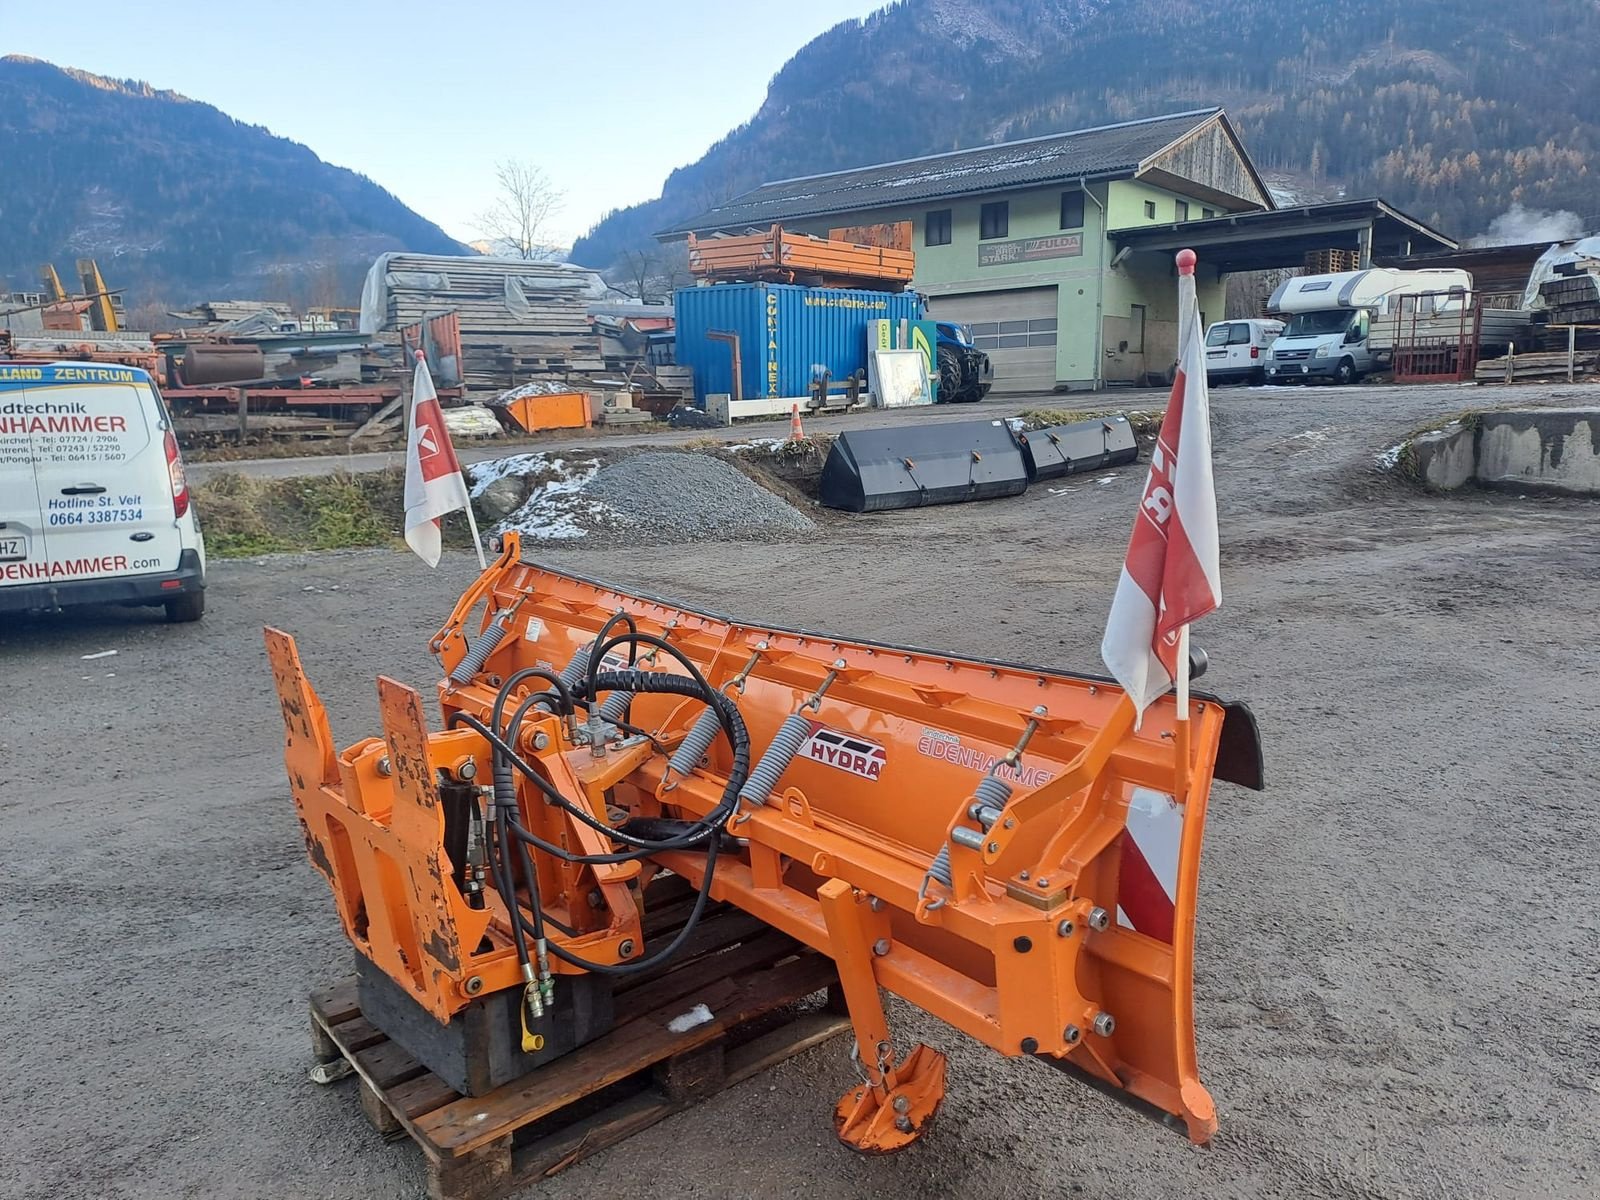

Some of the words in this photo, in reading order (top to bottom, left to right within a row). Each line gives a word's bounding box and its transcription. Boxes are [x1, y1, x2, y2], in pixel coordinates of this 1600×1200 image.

[1039, 237, 1079, 249] FULDA
[981, 252, 1019, 264] STARK.
[767, 294, 778, 393] CONTAINEX
[0, 368, 42, 379] LAND
[54, 368, 134, 382] ZENTRUM
[59, 435, 88, 443] 07724
[96, 434, 118, 443] 2906
[56, 444, 85, 453] 07243
[94, 444, 121, 452] 52290
[50, 454, 66, 462] Tel:
[68, 453, 97, 461] 06415
[105, 453, 126, 461] 5607
[48, 498, 94, 509] Hotline
[98, 497, 114, 507] St.
[118, 495, 142, 505] Veit
[50, 512, 83, 526] 0664
[88, 508, 143, 524] 3387534
[811, 741, 880, 778] HYDRA
